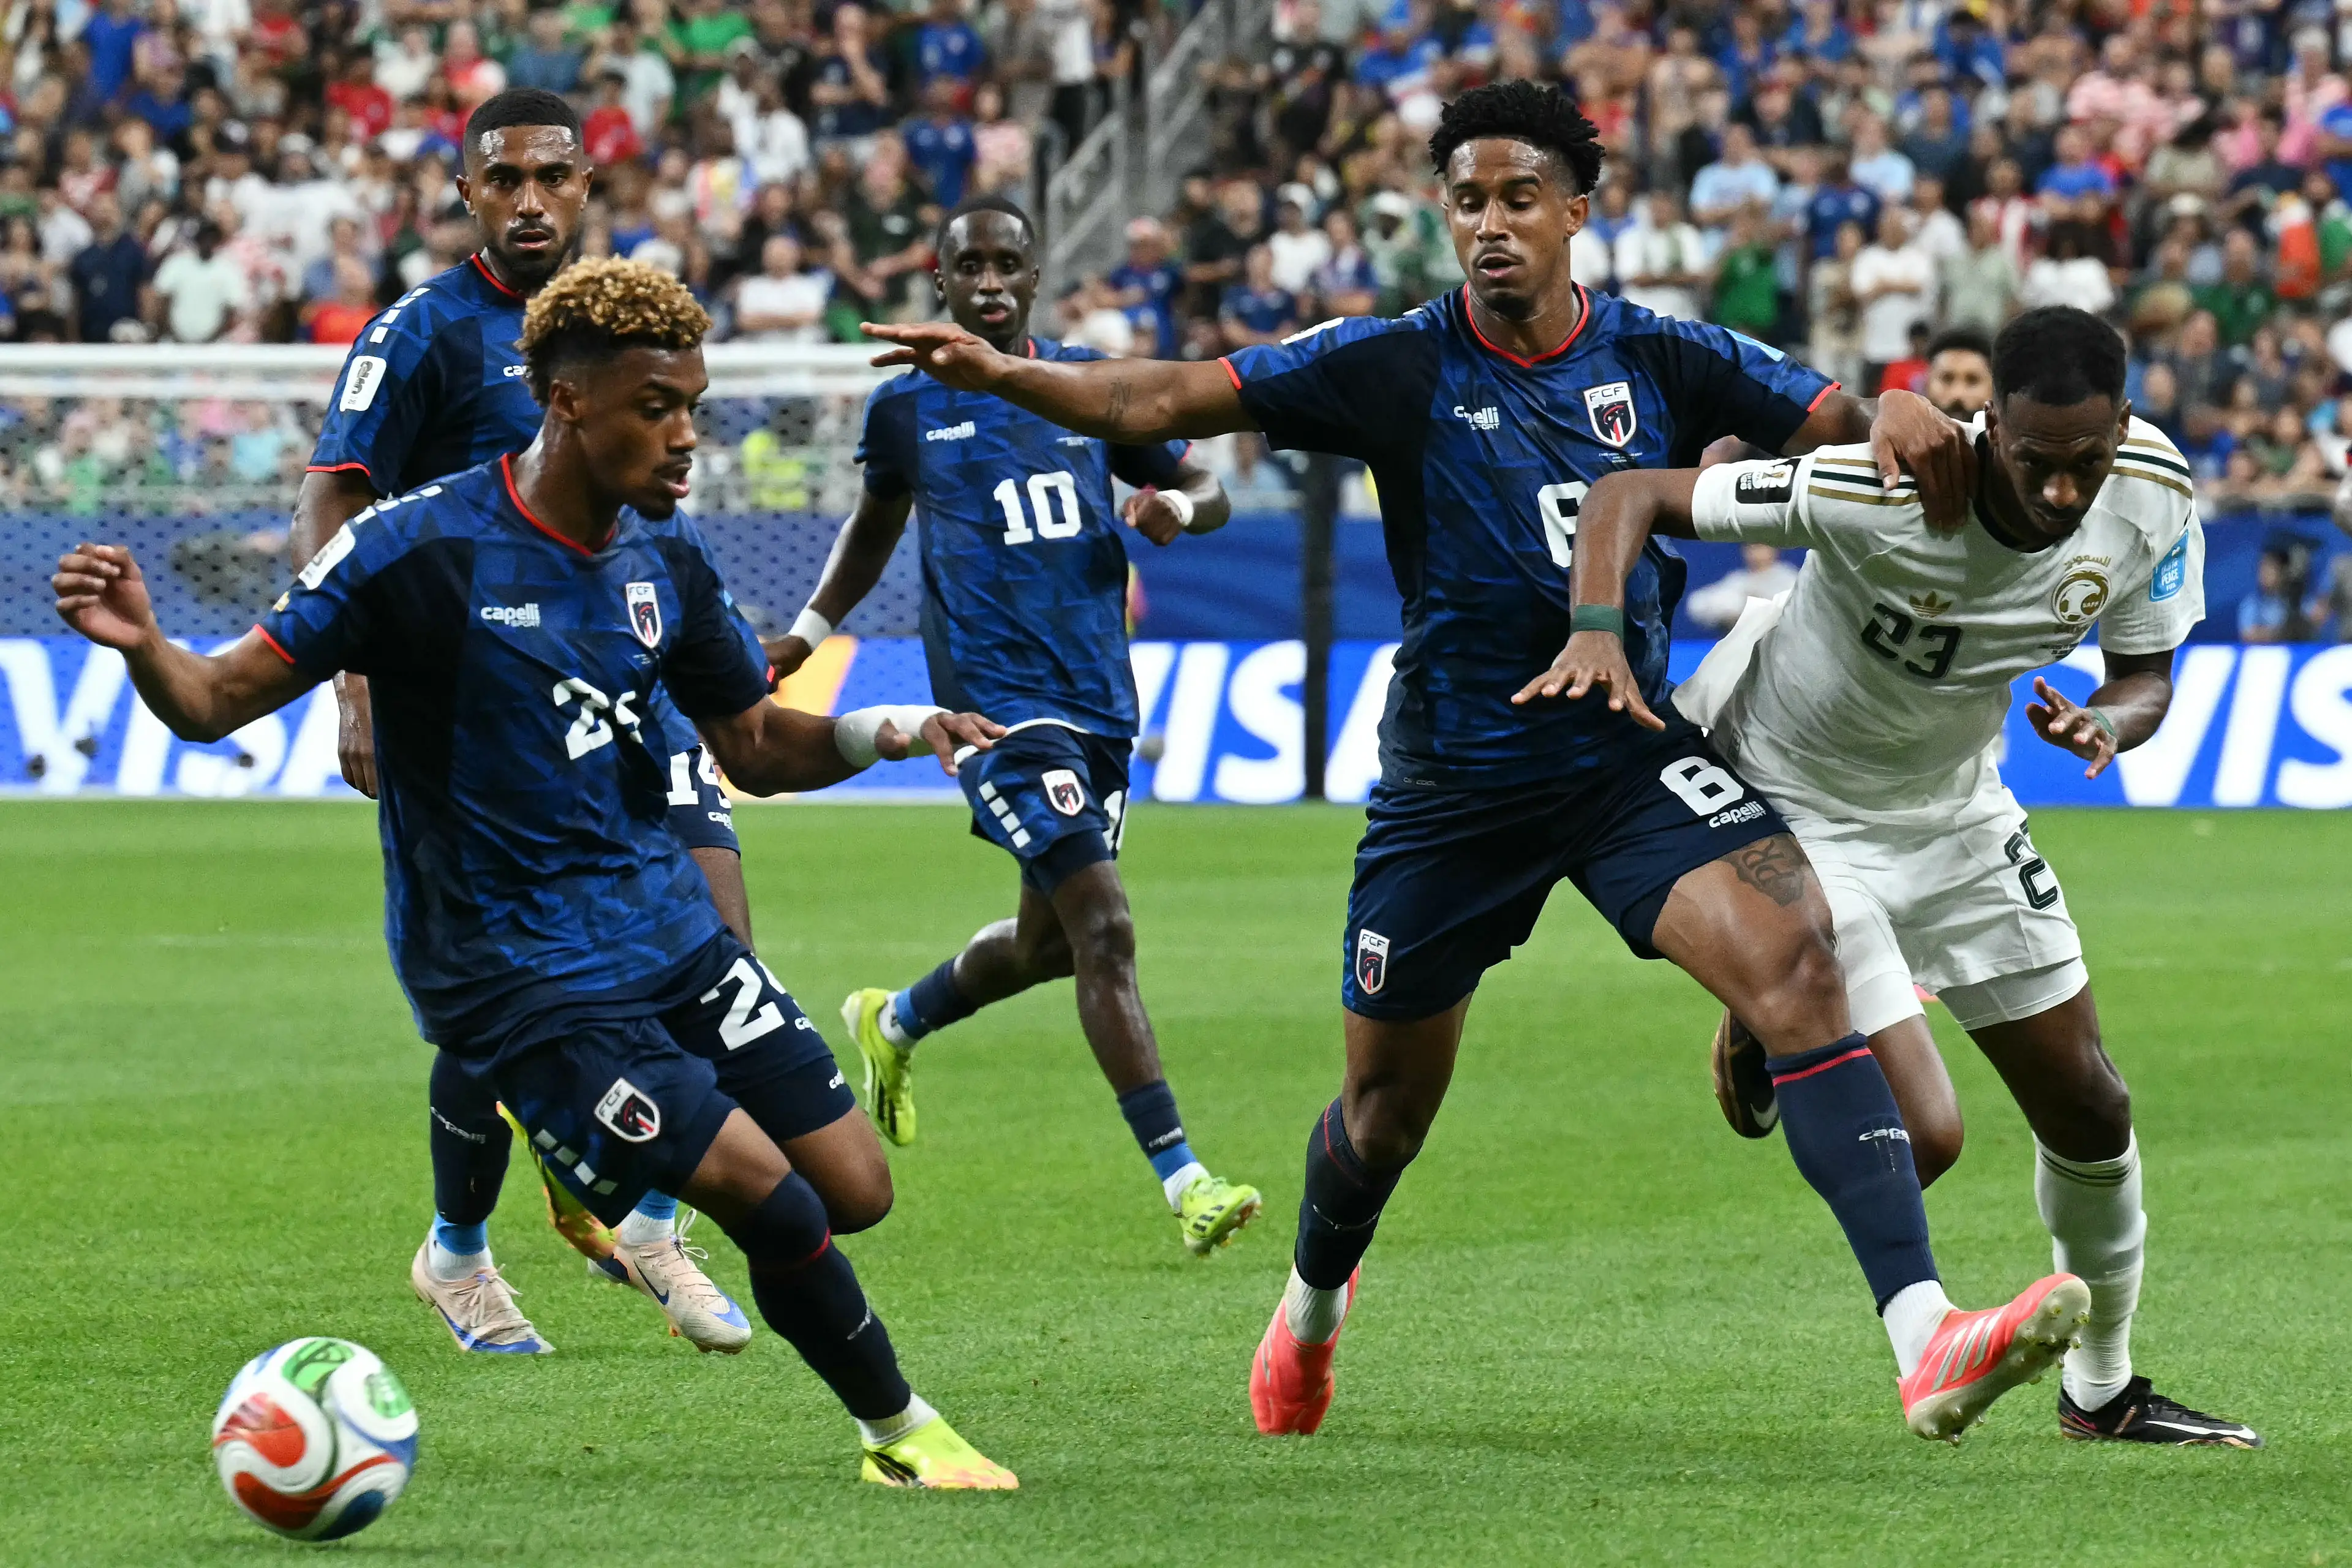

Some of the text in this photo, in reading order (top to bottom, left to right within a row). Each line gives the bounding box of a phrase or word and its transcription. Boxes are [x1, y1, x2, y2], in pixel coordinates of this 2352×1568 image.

[1589, 386, 1624, 402] FCF
[993, 470, 1082, 546] 10
[481, 603, 540, 625] capelli
[1861, 603, 1964, 679] 23
[1659, 756, 1744, 816] 6
[1708, 800, 1765, 829] capelli
[1740, 809, 1767, 824] SPORT
[1362, 933, 1386, 948] FCF
